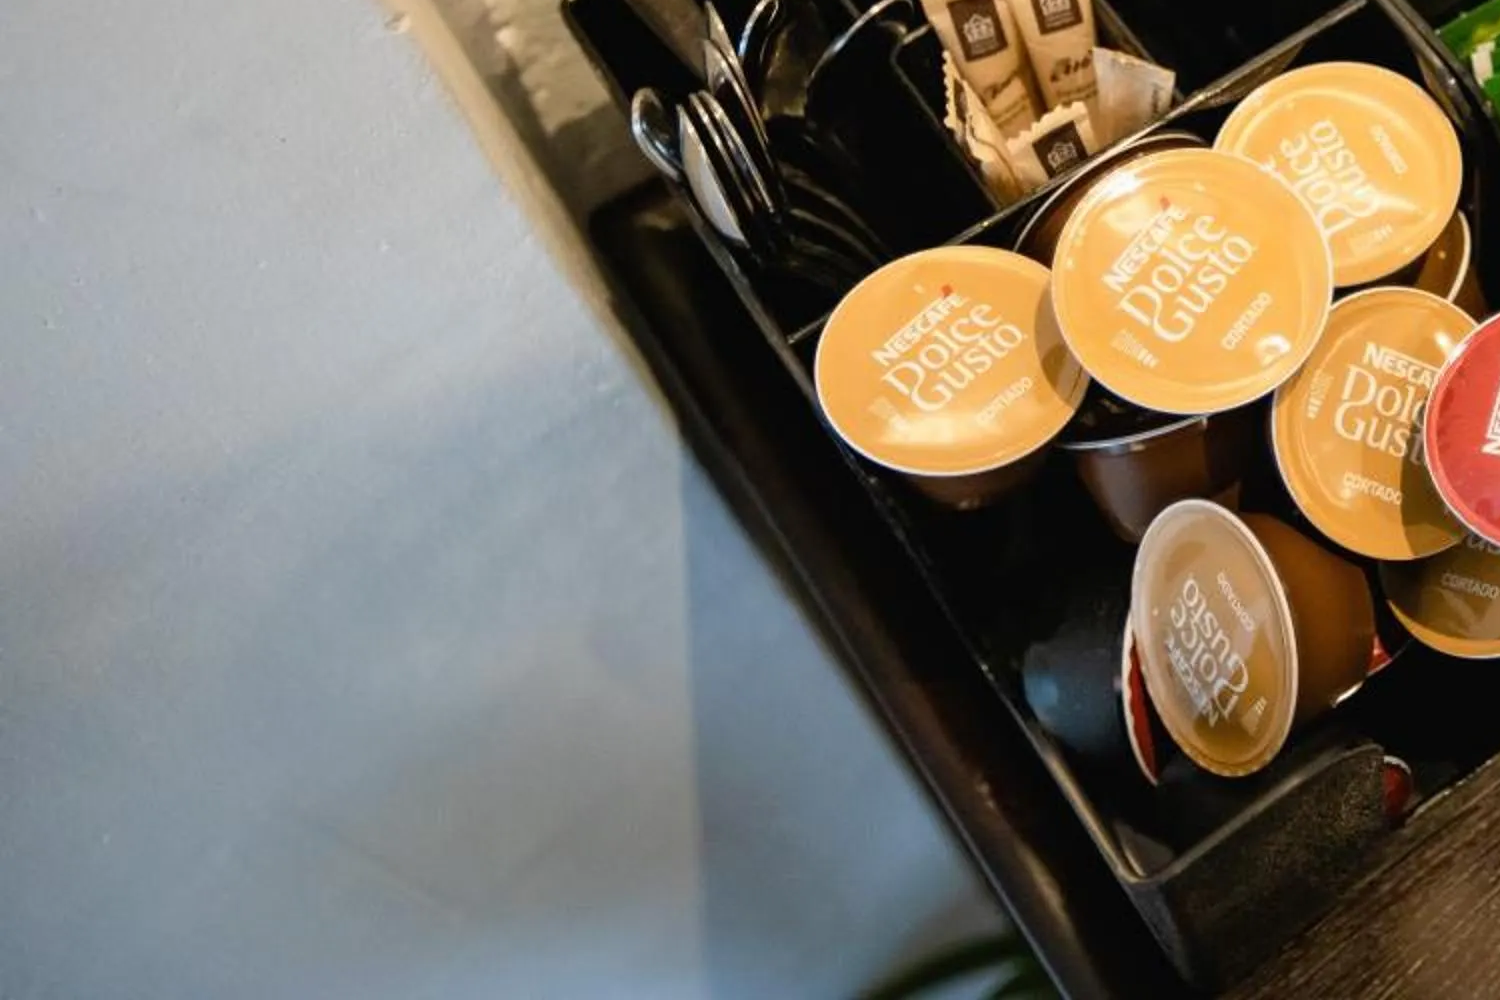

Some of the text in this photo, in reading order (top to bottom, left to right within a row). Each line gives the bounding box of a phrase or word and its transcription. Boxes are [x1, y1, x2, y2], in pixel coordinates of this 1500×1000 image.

[1117, 215, 1228, 327] Dolce
[1152, 235, 1254, 342] Gusto
[881, 303, 1003, 397] Dolce
[1220, 291, 1274, 351] CORTADO
[911, 323, 1026, 412] Gusto
[1340, 364, 1426, 430] Dolc
[1363, 341, 1438, 390] NESCA
[1334, 402, 1427, 466] Gust
[1343, 471, 1404, 506] CORTADO
[1441, 571, 1500, 601] CORTADO
[1170, 597, 1241, 722] Dolce
[1182, 576, 1249, 694] Gusto
